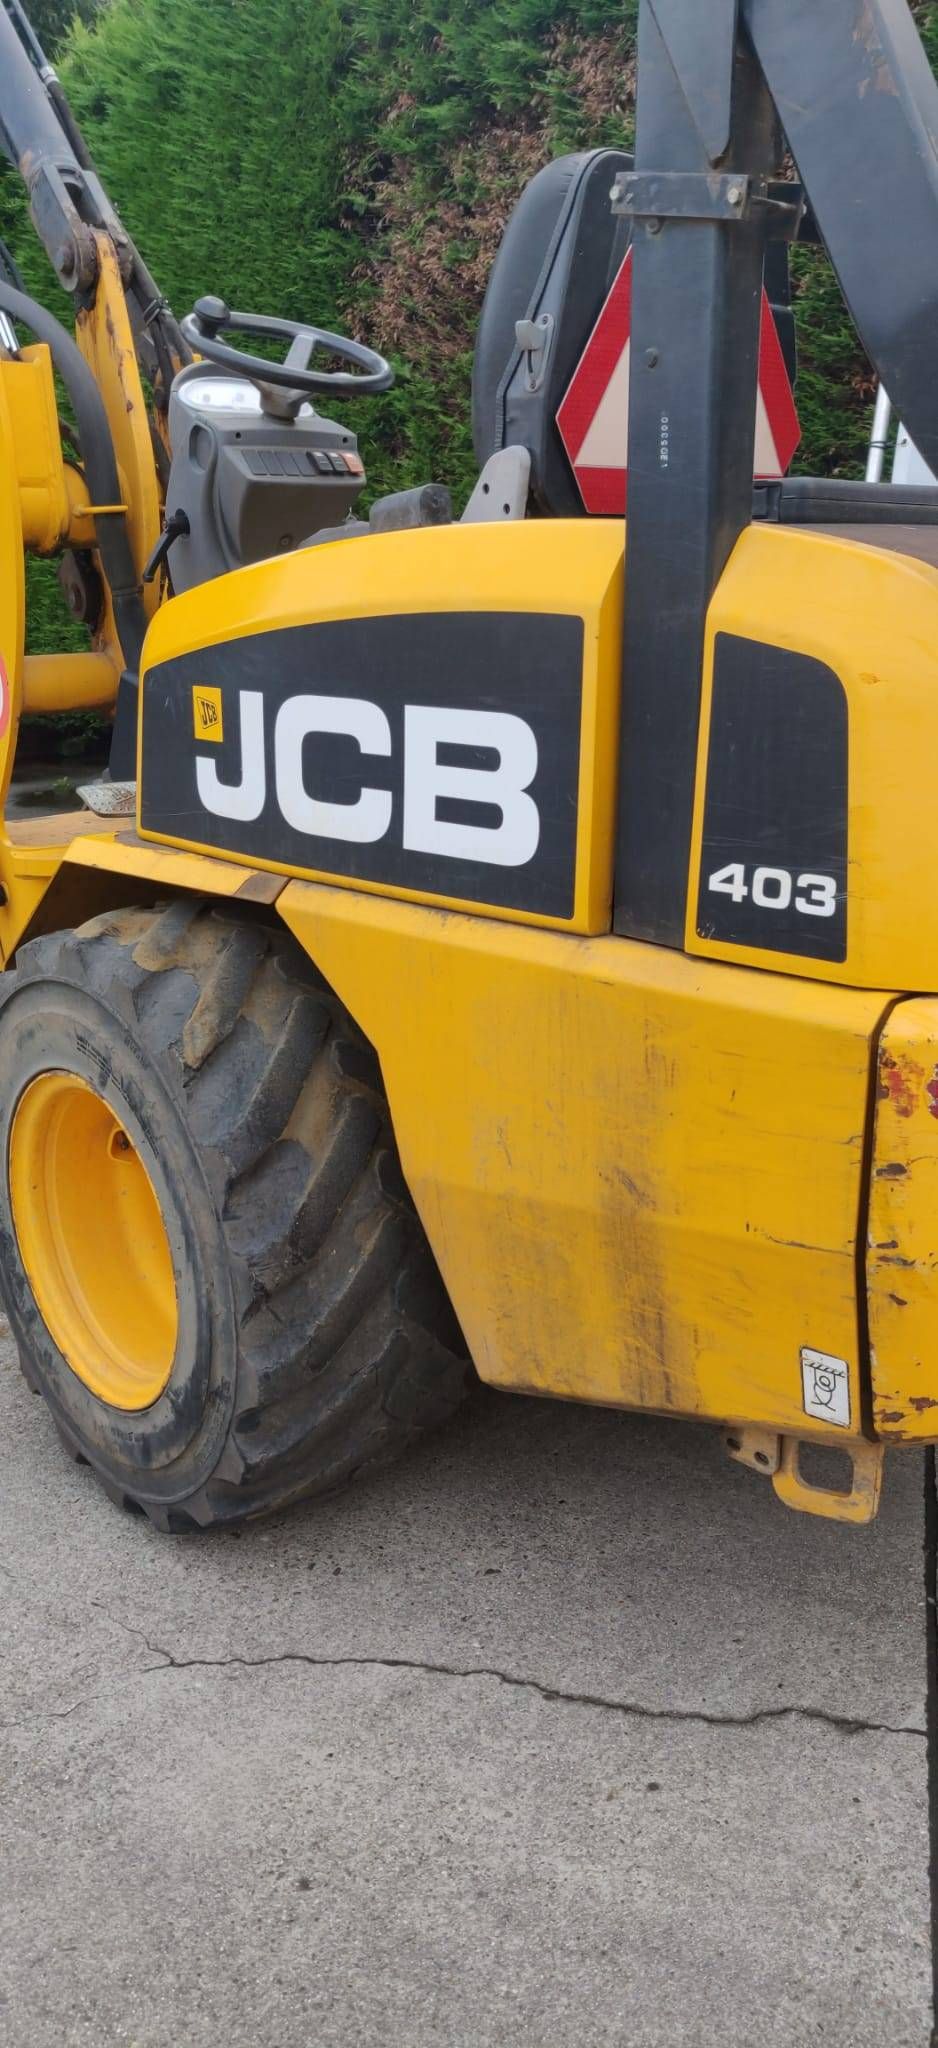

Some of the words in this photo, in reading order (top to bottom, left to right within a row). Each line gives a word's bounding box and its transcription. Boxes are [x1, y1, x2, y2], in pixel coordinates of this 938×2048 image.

[200, 699, 218, 726] JCB
[196, 690, 541, 867] JCB
[708, 862, 838, 918] 403
